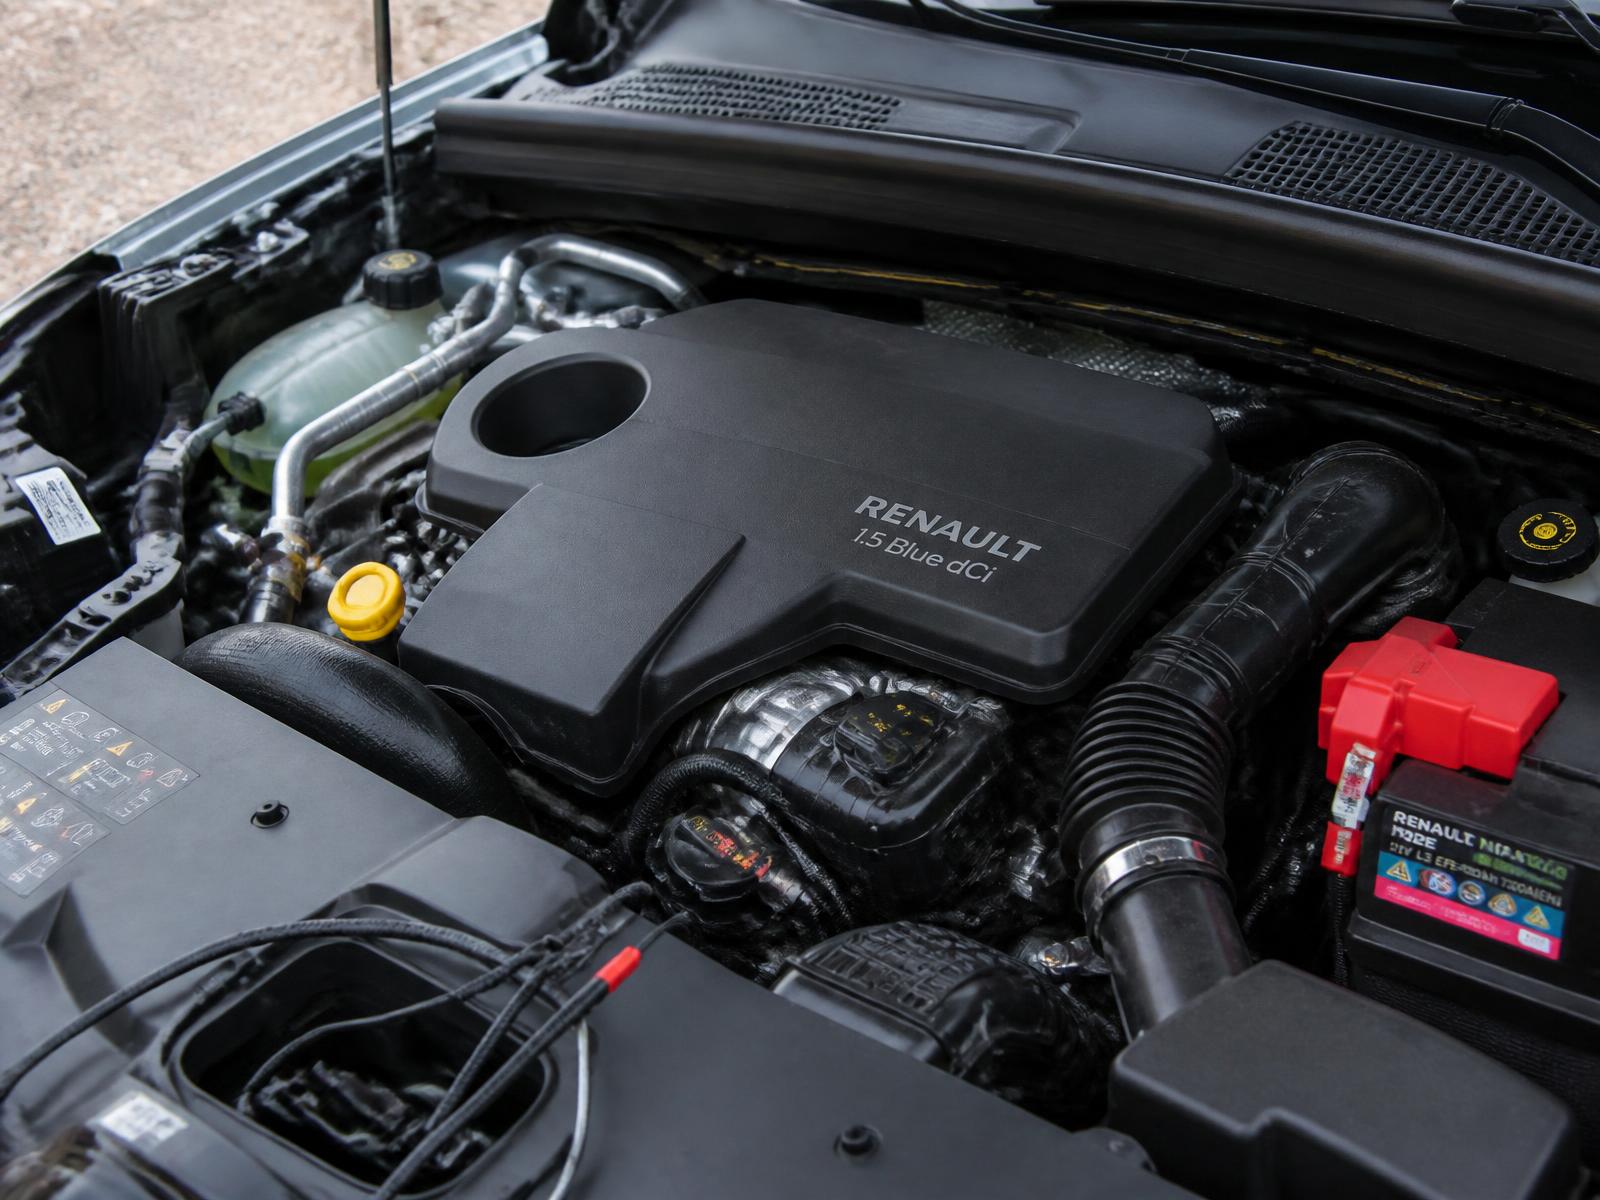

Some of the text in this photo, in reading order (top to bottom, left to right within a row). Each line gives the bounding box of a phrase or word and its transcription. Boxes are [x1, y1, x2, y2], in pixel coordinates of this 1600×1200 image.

[852, 527, 998, 583] 1.5 Blue dCi
[854, 495, 1042, 562] RENAULT
[1393, 810, 1476, 847] RENAULT
